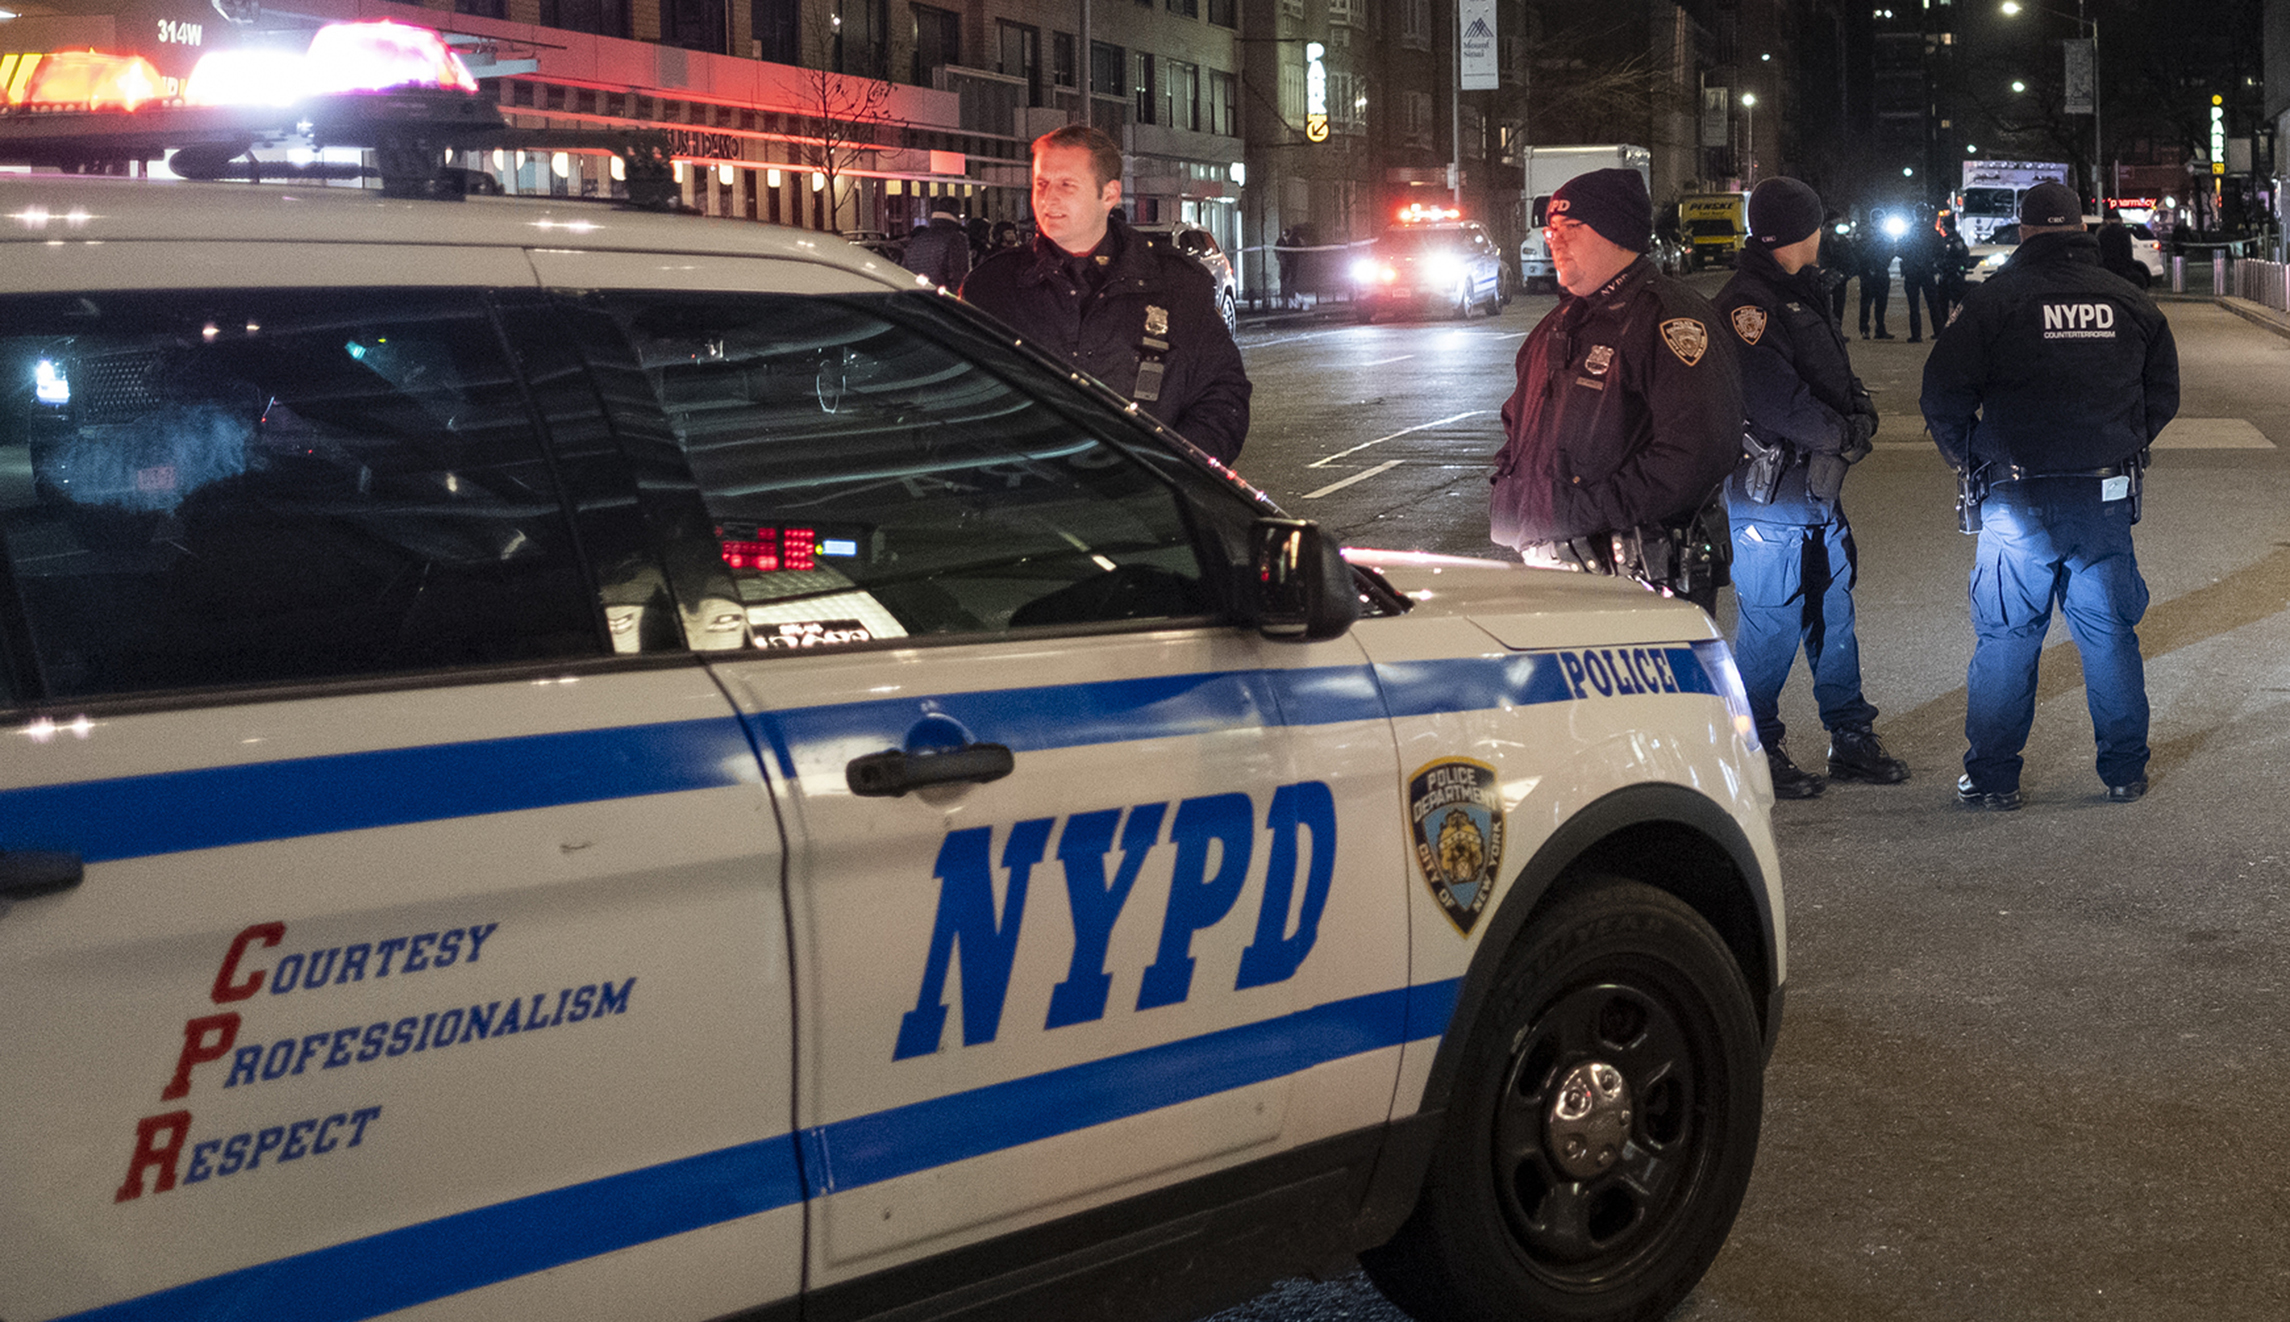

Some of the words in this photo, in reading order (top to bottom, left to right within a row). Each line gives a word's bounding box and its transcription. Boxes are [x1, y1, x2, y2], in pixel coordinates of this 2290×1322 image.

[157, 19, 203, 46] 314W
[1306, 42, 1327, 115] PARK
[2210, 106, 2224, 163] PARK
[1689, 202, 1733, 211] PENSKE
[2043, 304, 2114, 329] NYPD
[2043, 331, 2116, 339] COUNTERTERRORISM
[1560, 648, 1678, 699] POLICE
[1413, 785, 1498, 824] DEPARTMENT
[1427, 766, 1478, 791] POLICE
[1418, 843, 1441, 883] CITY
[1438, 888, 1456, 909] OF
[1472, 873, 1493, 913] NEW
[1488, 821, 1503, 867] YORK
[892, 780, 1338, 1063] NYPD
[209, 920, 500, 1005] COURTESY
[160, 976, 638, 1102] PROFESSIONALISM
[113, 1104, 383, 1204] RESPECT
